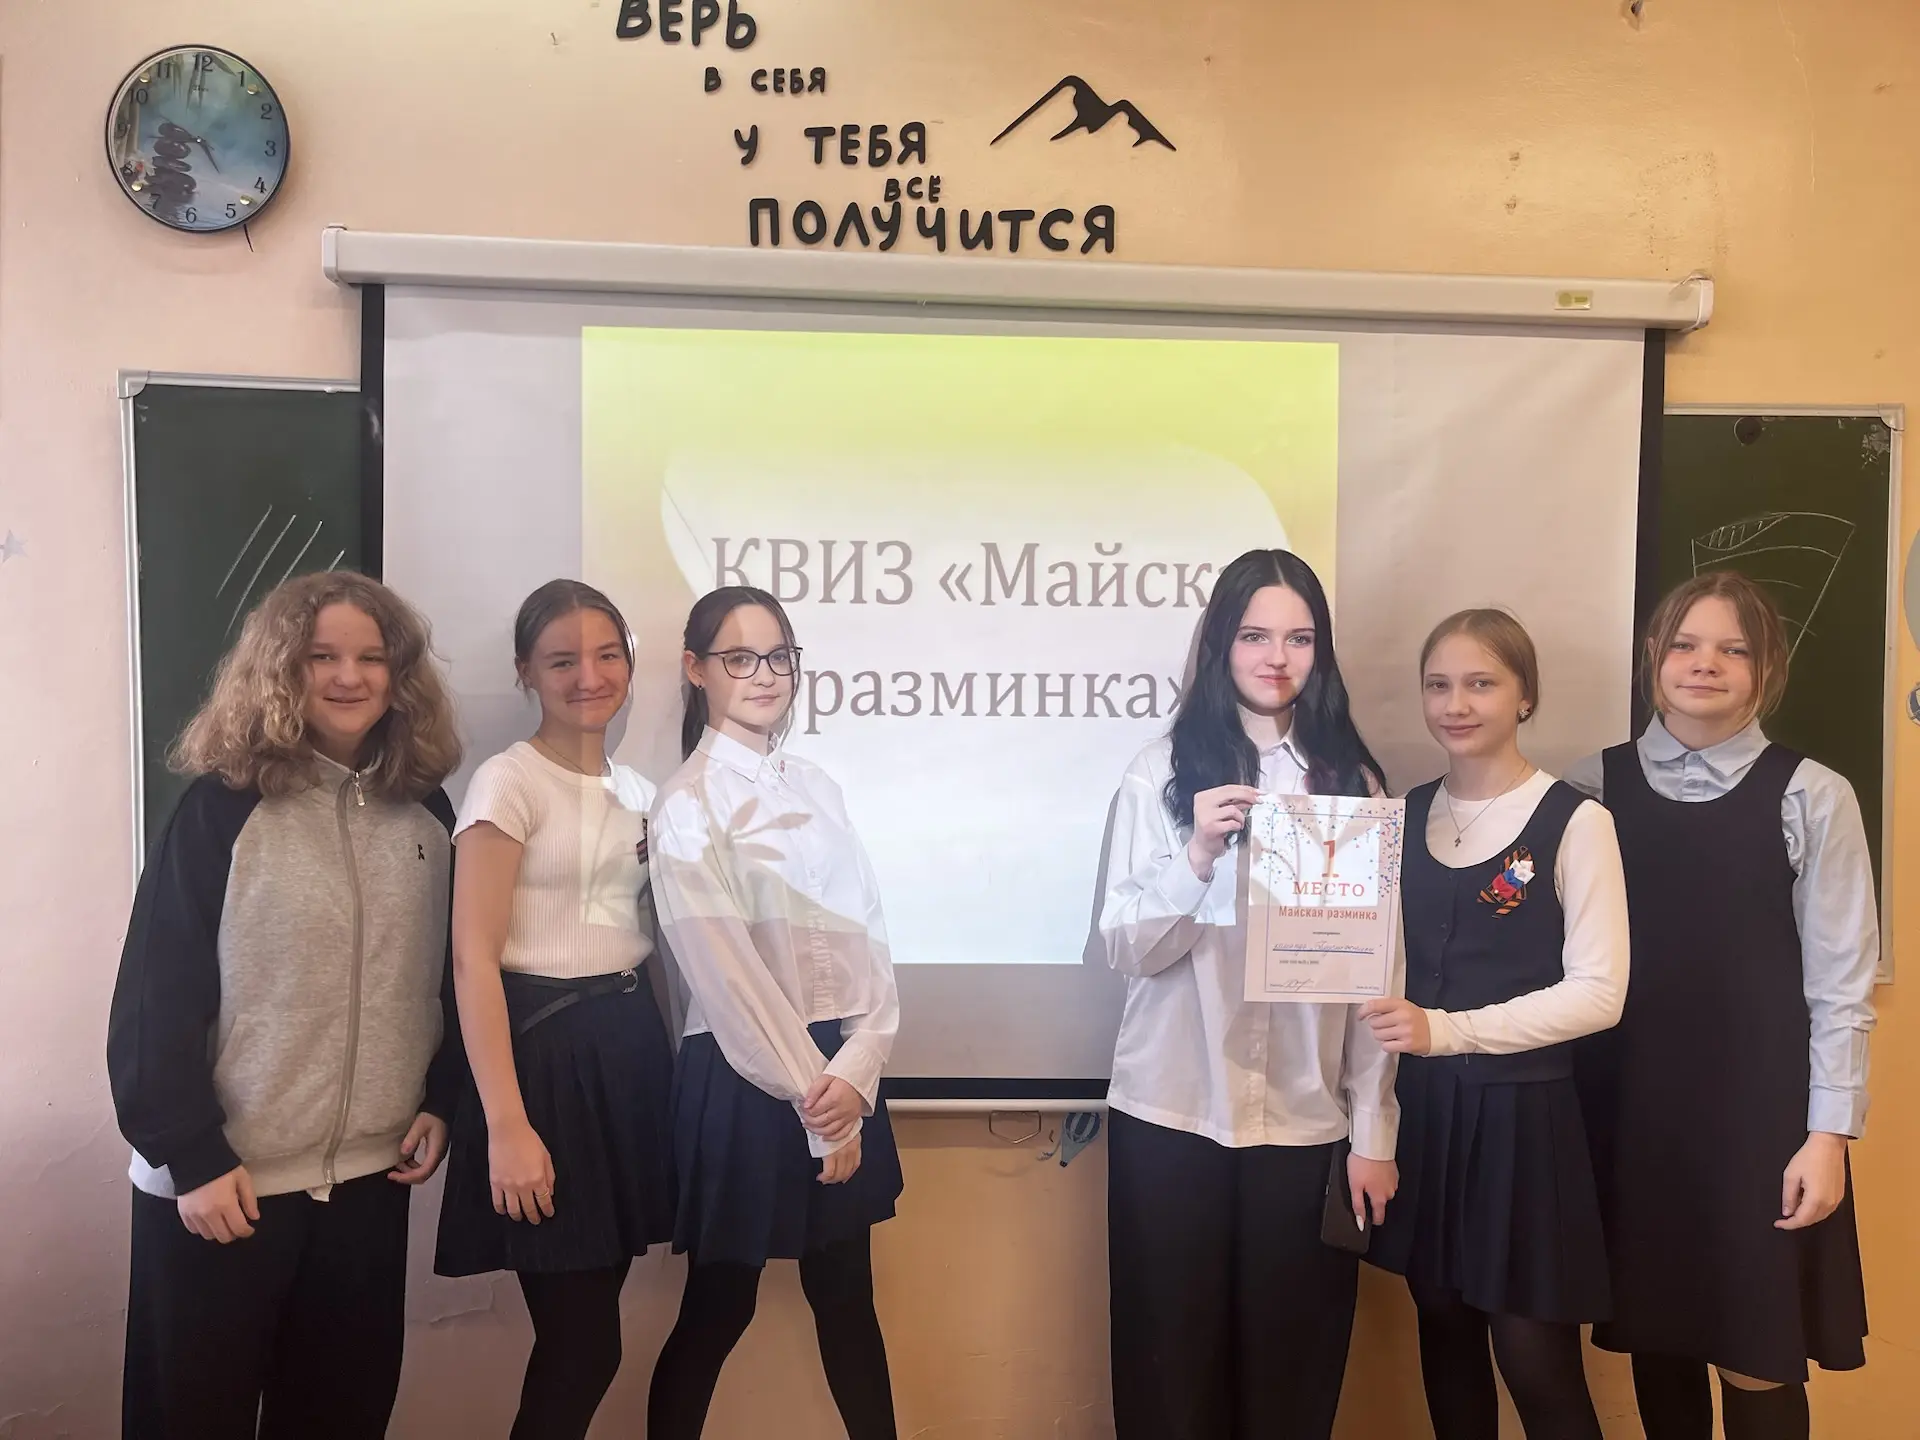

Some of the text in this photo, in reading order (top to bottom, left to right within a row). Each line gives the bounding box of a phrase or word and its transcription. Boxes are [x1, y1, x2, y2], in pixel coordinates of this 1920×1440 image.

[616, 0, 757, 49] ВЕРЬ
[156, 62, 171, 79] 11
[193, 54, 214, 72] 12
[237, 70, 245, 87] 1
[704, 66, 826, 94] В СЕБЯ
[129, 88, 149, 105] 10
[260, 103, 273, 120] 2
[264, 140, 276, 157] 3
[734, 122, 926, 167] У ТЕБЯ
[122, 162, 133, 176] 8
[254, 176, 267, 193] 4
[150, 193, 161, 209] 7
[185, 207, 197, 223] 6
[225, 203, 236, 218] 5
[749, 197, 1115, 254] ПОЛУЧИТСЯ
[711, 537, 913, 605] КВИЗ
[1322, 840, 1339, 878] 1
[1292, 881, 1365, 896] МЕСТО
[1278, 905, 1378, 921] Майская разминка
